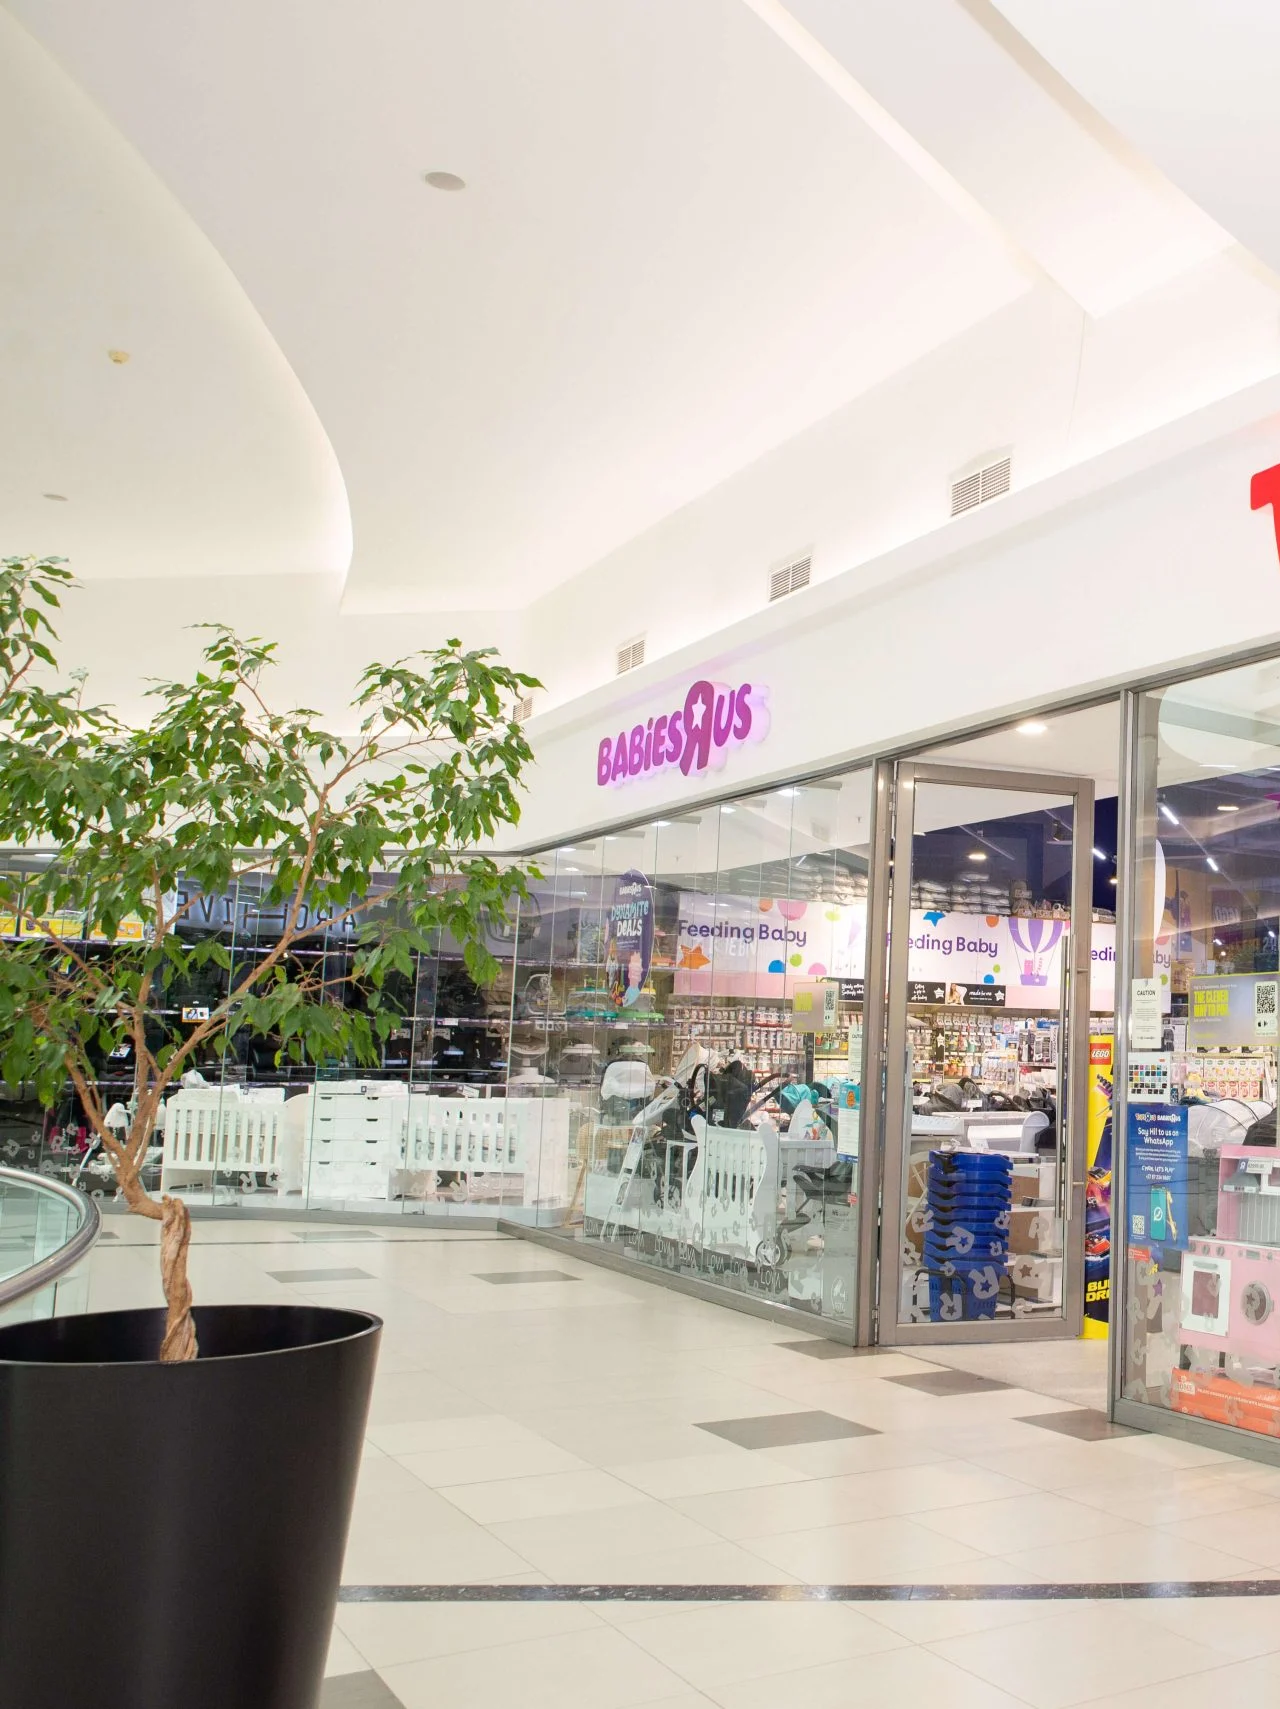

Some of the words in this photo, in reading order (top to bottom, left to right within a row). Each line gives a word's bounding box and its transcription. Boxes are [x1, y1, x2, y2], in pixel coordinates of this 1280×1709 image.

[678, 920, 755, 944] Feeding
[758, 924, 807, 947] Baby
[956, 936, 998, 958] Baby
[1092, 1049, 1110, 1058] LEGO
[1138, 1127, 1149, 1136] Say
[1144, 1137, 1173, 1147] WhatsApp
